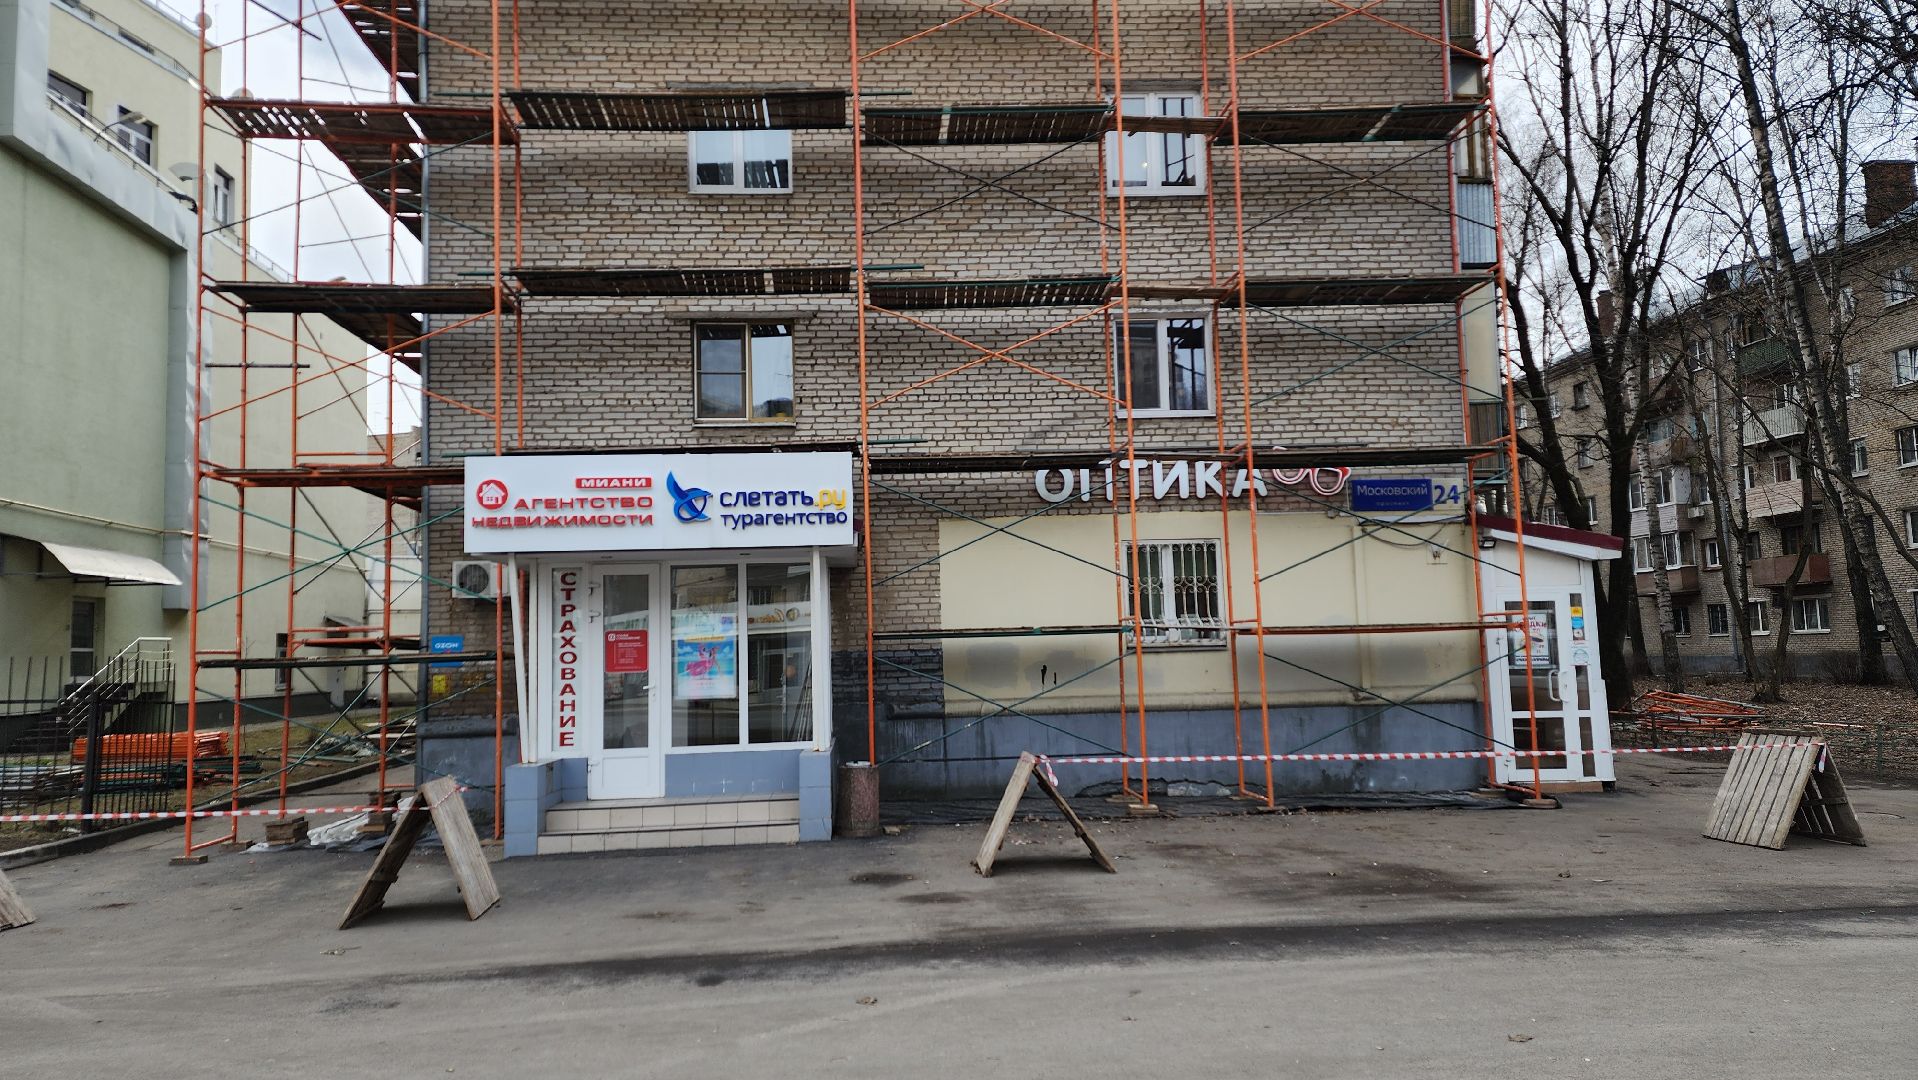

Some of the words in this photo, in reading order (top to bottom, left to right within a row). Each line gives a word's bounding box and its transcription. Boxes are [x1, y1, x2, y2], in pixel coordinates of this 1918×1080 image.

[581, 478, 647, 487] МИАНИ
[1357, 483, 1428, 496] Московский
[720, 489, 846, 510] слетать.ру
[1434, 485, 1460, 504] 24
[514, 497, 653, 509] АГЕНТСТВО
[472, 515, 653, 528] НЕДВИЖИМОСТИ
[720, 512, 848, 530] турагентство
[559, 572, 577, 747] СТРАХОВАНИЕ
